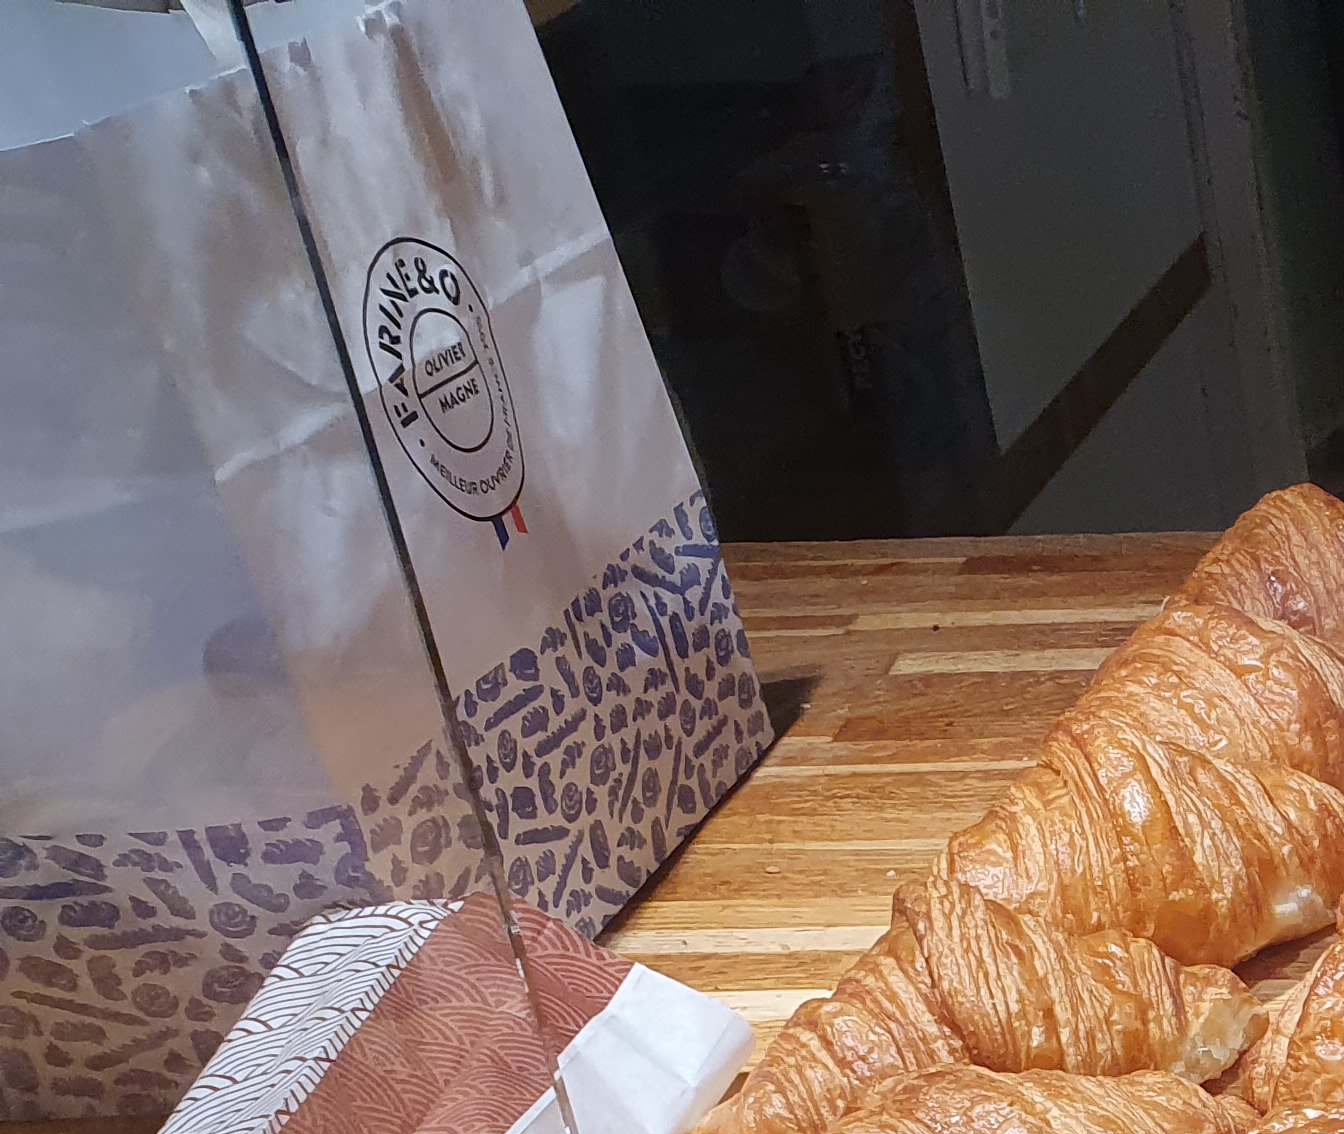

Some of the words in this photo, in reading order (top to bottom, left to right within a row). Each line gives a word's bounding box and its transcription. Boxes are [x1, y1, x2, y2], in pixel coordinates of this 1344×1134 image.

[424, 341, 467, 377] OLIVIER
[438, 377, 481, 414] MAGNE
[430, 453, 479, 496] MEILLEUR
[479, 449, 515, 496] OUVRIER
